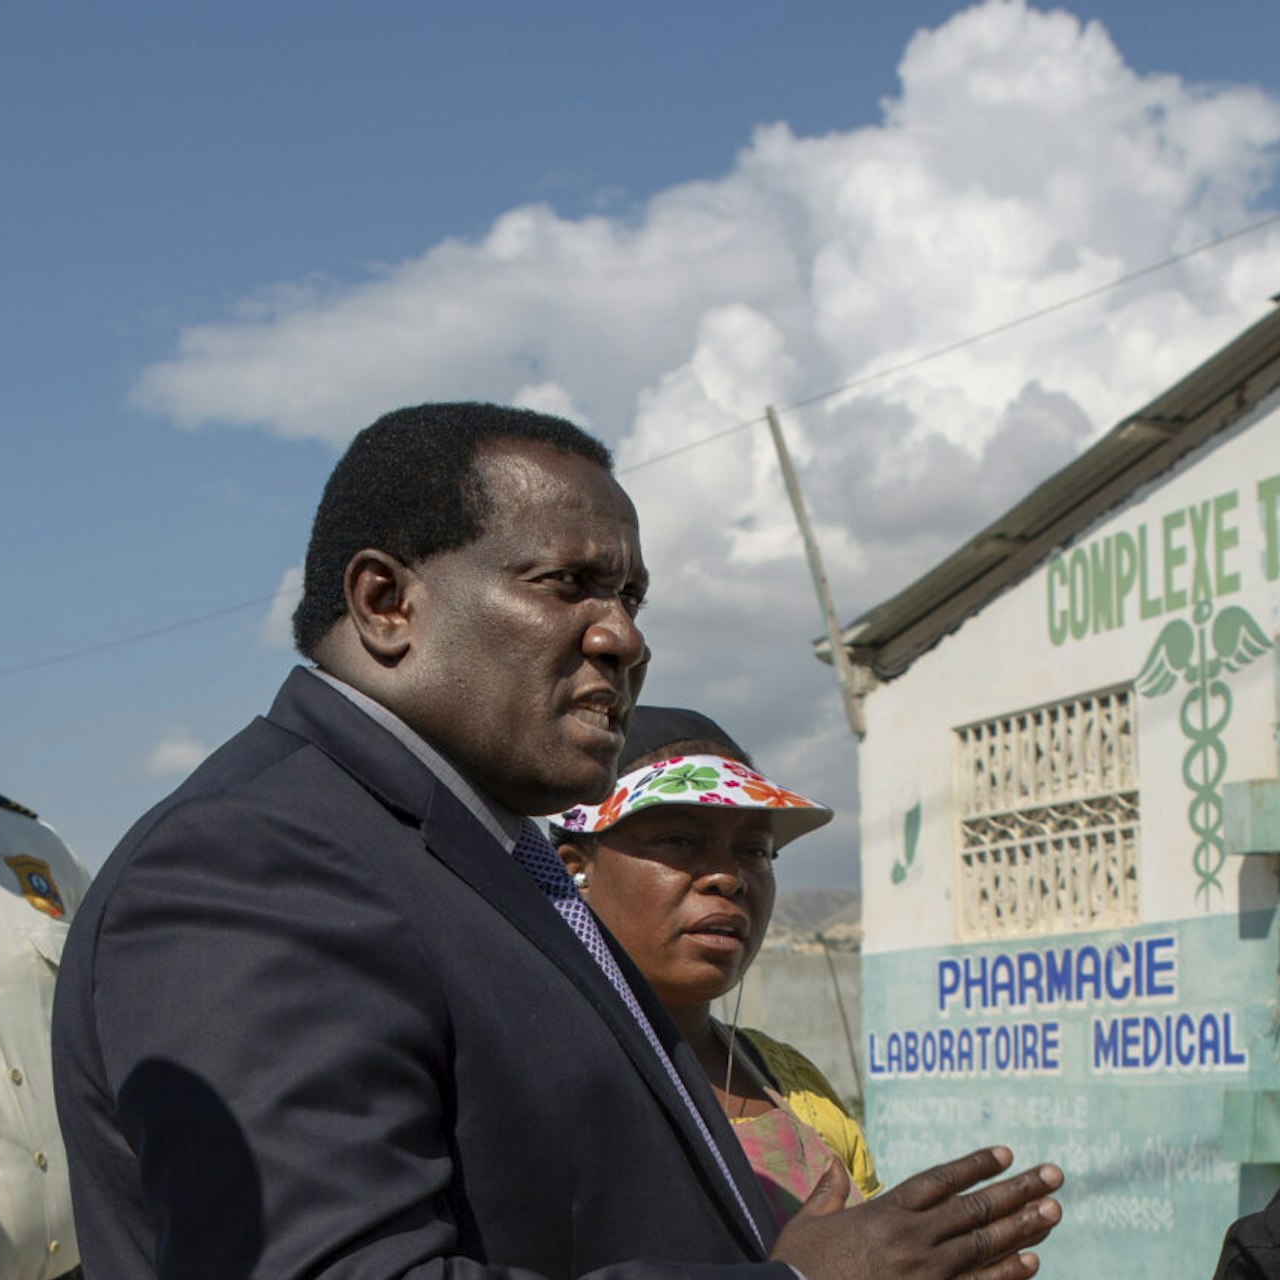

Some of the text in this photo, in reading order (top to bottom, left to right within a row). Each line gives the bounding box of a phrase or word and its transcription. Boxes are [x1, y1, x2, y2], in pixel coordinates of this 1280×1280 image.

[1046, 489, 1242, 647] COMPLEXE
[937, 936, 1176, 1012] PHARMACIE
[869, 1012, 1247, 1075] LABORATOIRE MEDICAL
